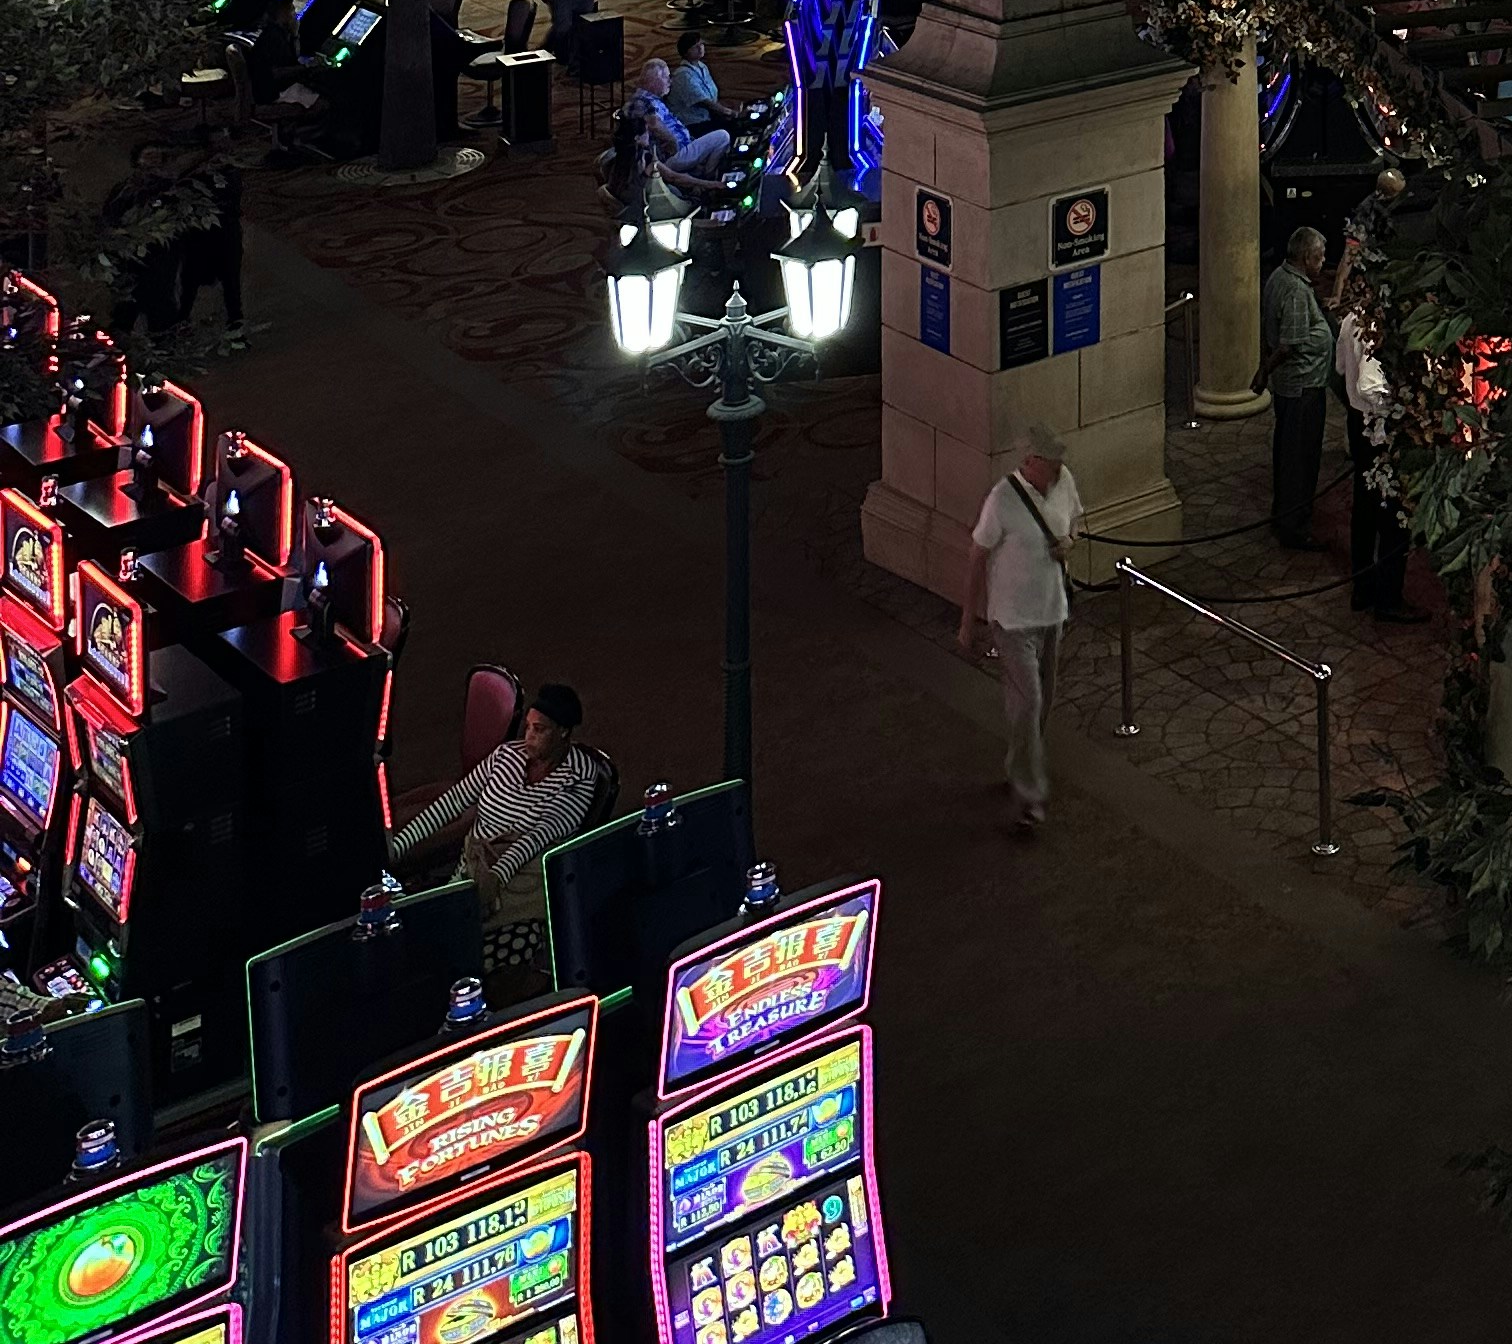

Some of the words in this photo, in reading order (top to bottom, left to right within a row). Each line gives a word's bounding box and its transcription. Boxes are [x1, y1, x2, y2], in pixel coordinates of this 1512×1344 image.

[1057, 232, 1105, 250] Non-Smoking
[1072, 246, 1090, 257] Area
[712, 991, 731, 1009] JIN
[728, 981, 813, 1027] ENDLESS
[710, 989, 828, 1056] TREASURE
[403, 1117, 426, 1136] JIN
[430, 1106, 517, 1151] RISING
[710, 1116, 723, 1137] R
[729, 1099, 760, 1127] 103
[397, 1112, 544, 1192] FORTUNES
[720, 1148, 731, 1168] R
[736, 1136, 755, 1159] 24
[674, 1161, 717, 1190] MAJOR
[402, 1250, 416, 1272] R
[425, 1231, 460, 1263] 103
[413, 1286, 425, 1306] R
[431, 1273, 454, 1298] 24
[359, 1300, 409, 1330] MAJOR
